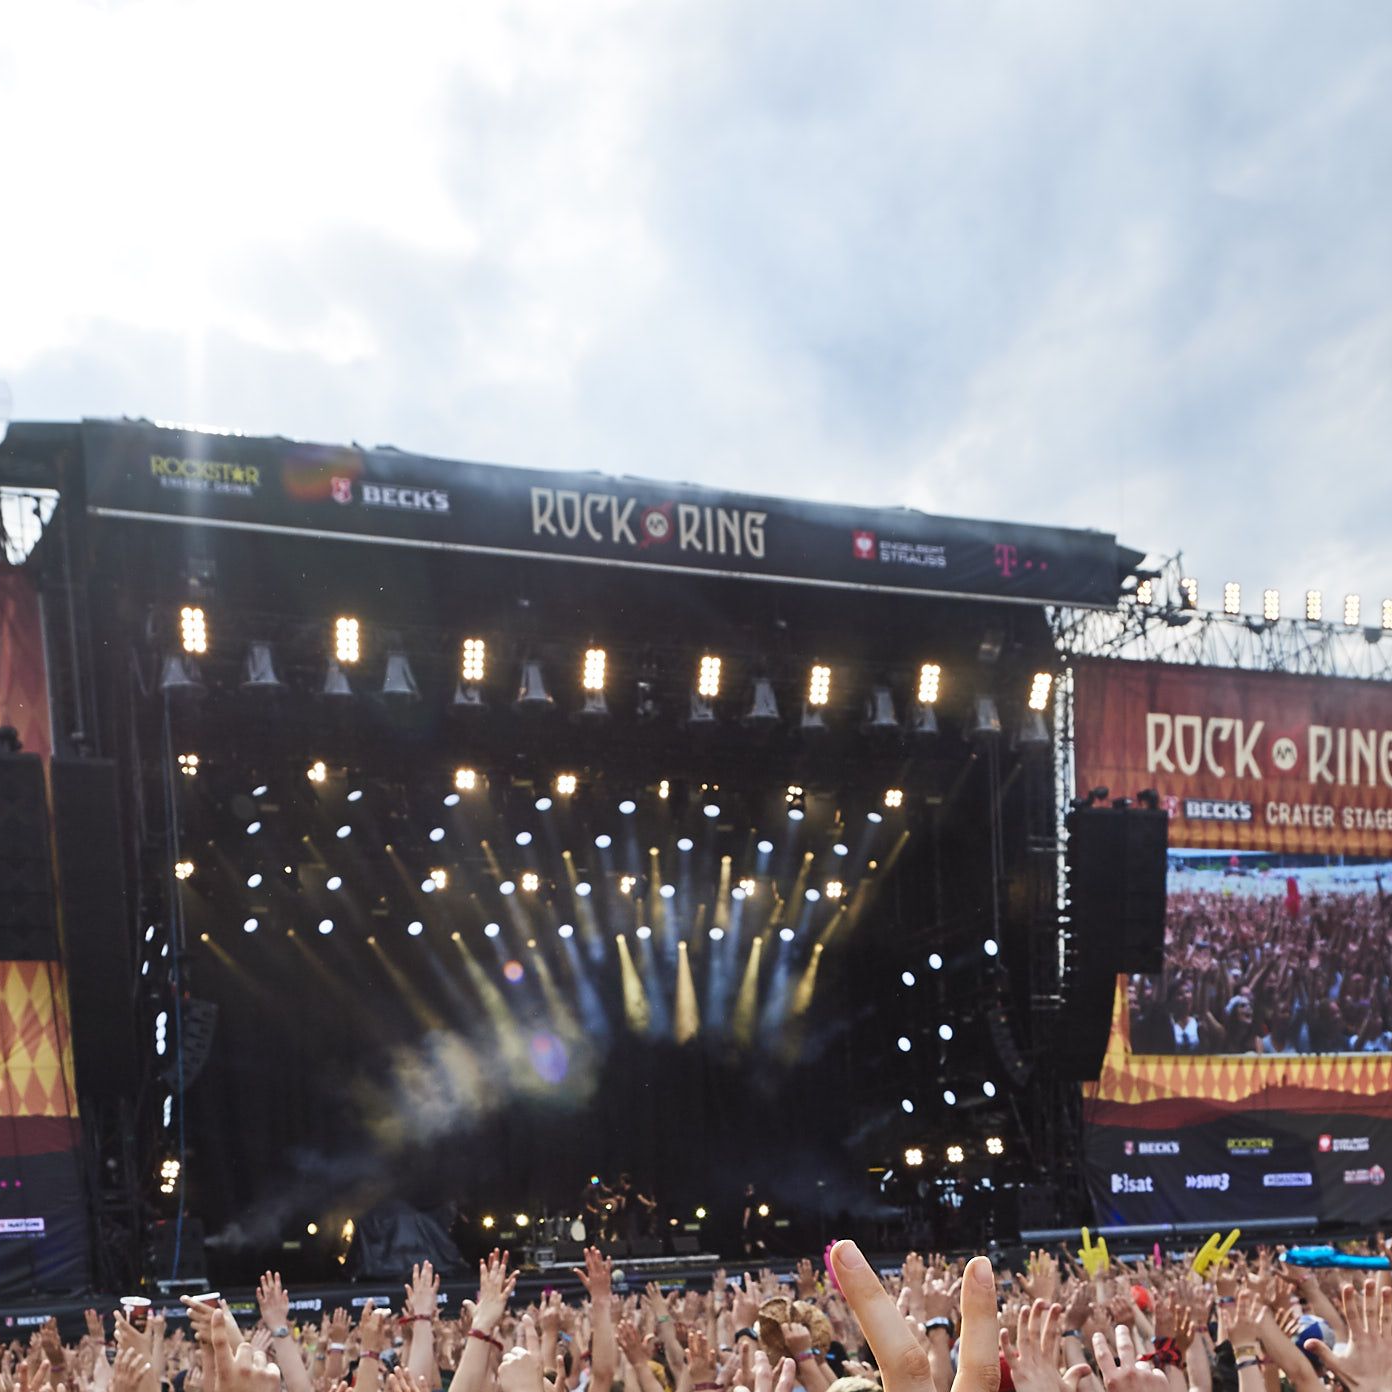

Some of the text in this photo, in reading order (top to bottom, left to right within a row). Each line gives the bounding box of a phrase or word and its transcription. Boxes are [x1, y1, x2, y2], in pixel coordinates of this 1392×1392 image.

[150, 456, 259, 485] ROCKSTAR
[363, 484, 450, 510] BECK'S
[530, 486, 636, 545] ROCK
[677, 503, 768, 559] RING
[880, 550, 947, 568] STRAUSS
[1146, 713, 1265, 780] ROCK
[1186, 801, 1252, 821] BECK'S
[1266, 801, 1335, 827] CRATER
